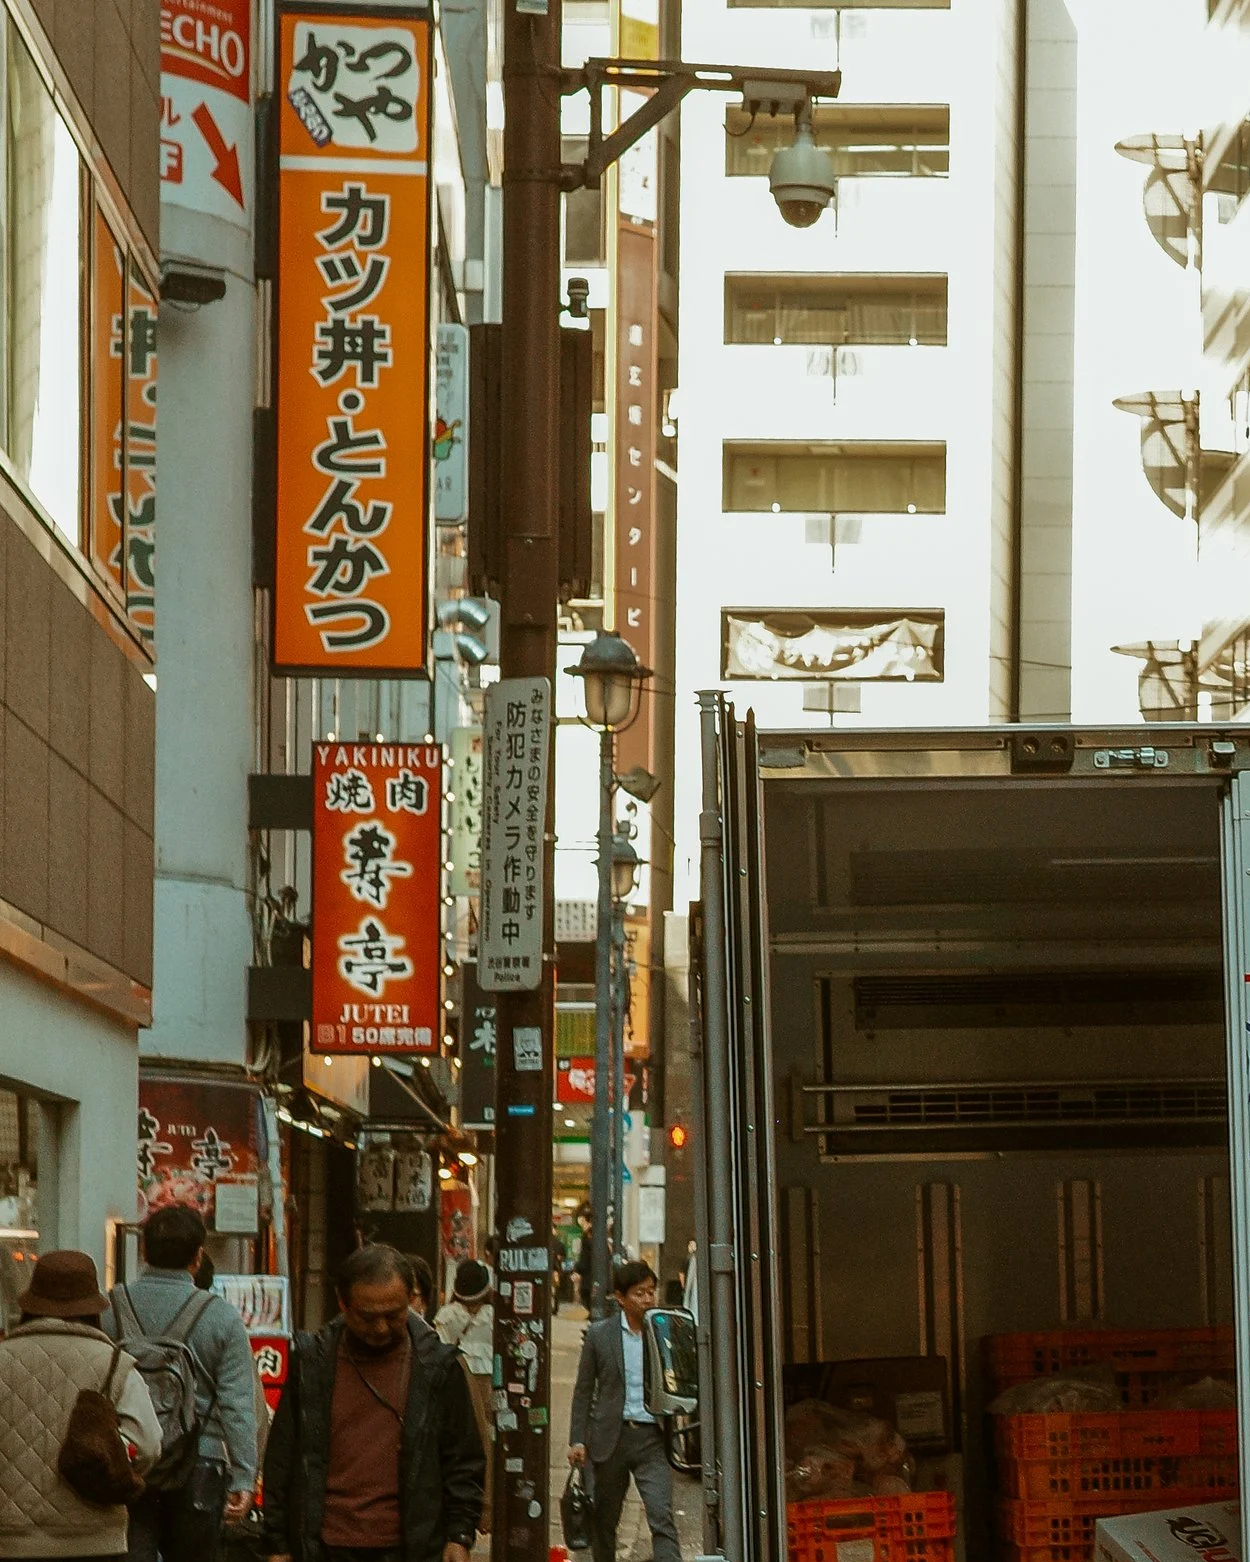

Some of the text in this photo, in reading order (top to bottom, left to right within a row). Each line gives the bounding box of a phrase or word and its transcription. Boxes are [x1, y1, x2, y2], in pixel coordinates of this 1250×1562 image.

[294, 31, 413, 144] かつや
[303, 181, 394, 654] カツ丼・とんかつ
[317, 745, 440, 768] YAKINIKU
[326, 768, 429, 815] 焼肉
[501, 701, 527, 946] 防犯カメラ作動中
[493, 969, 521, 982] Police
[340, 1003, 411, 1025] JUTEI
